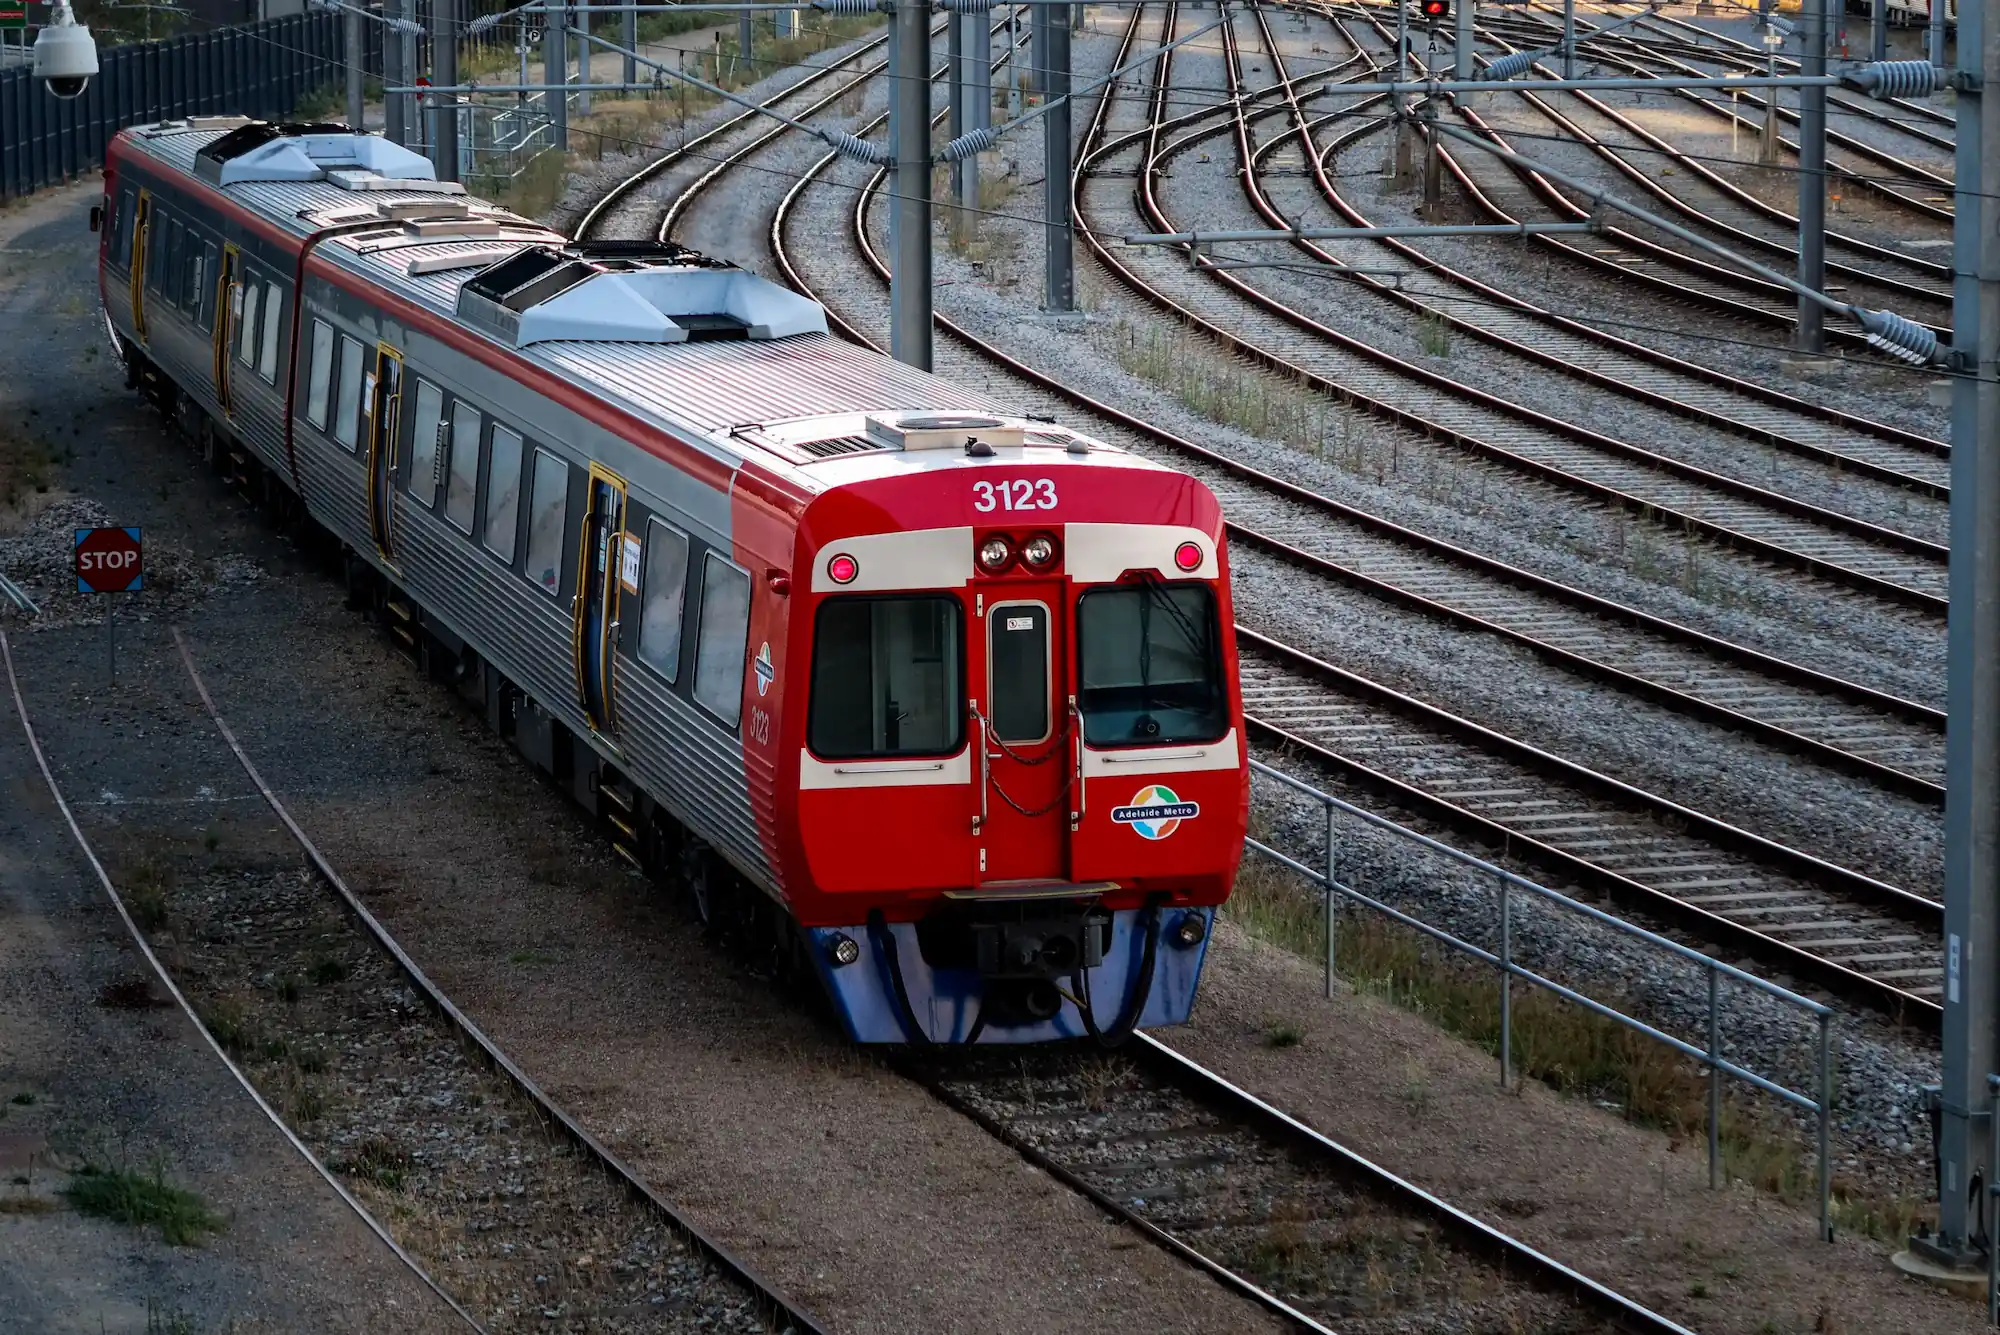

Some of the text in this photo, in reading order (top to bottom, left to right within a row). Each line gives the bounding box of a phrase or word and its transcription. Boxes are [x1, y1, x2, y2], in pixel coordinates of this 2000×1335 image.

[531, 31, 539, 41] P
[1428, 41, 1437, 52] A
[973, 478, 1058, 512] 3123
[80, 550, 137, 570] STOP
[750, 705, 769, 746] 3123
[1118, 807, 1192, 819] Adelaide Metro
